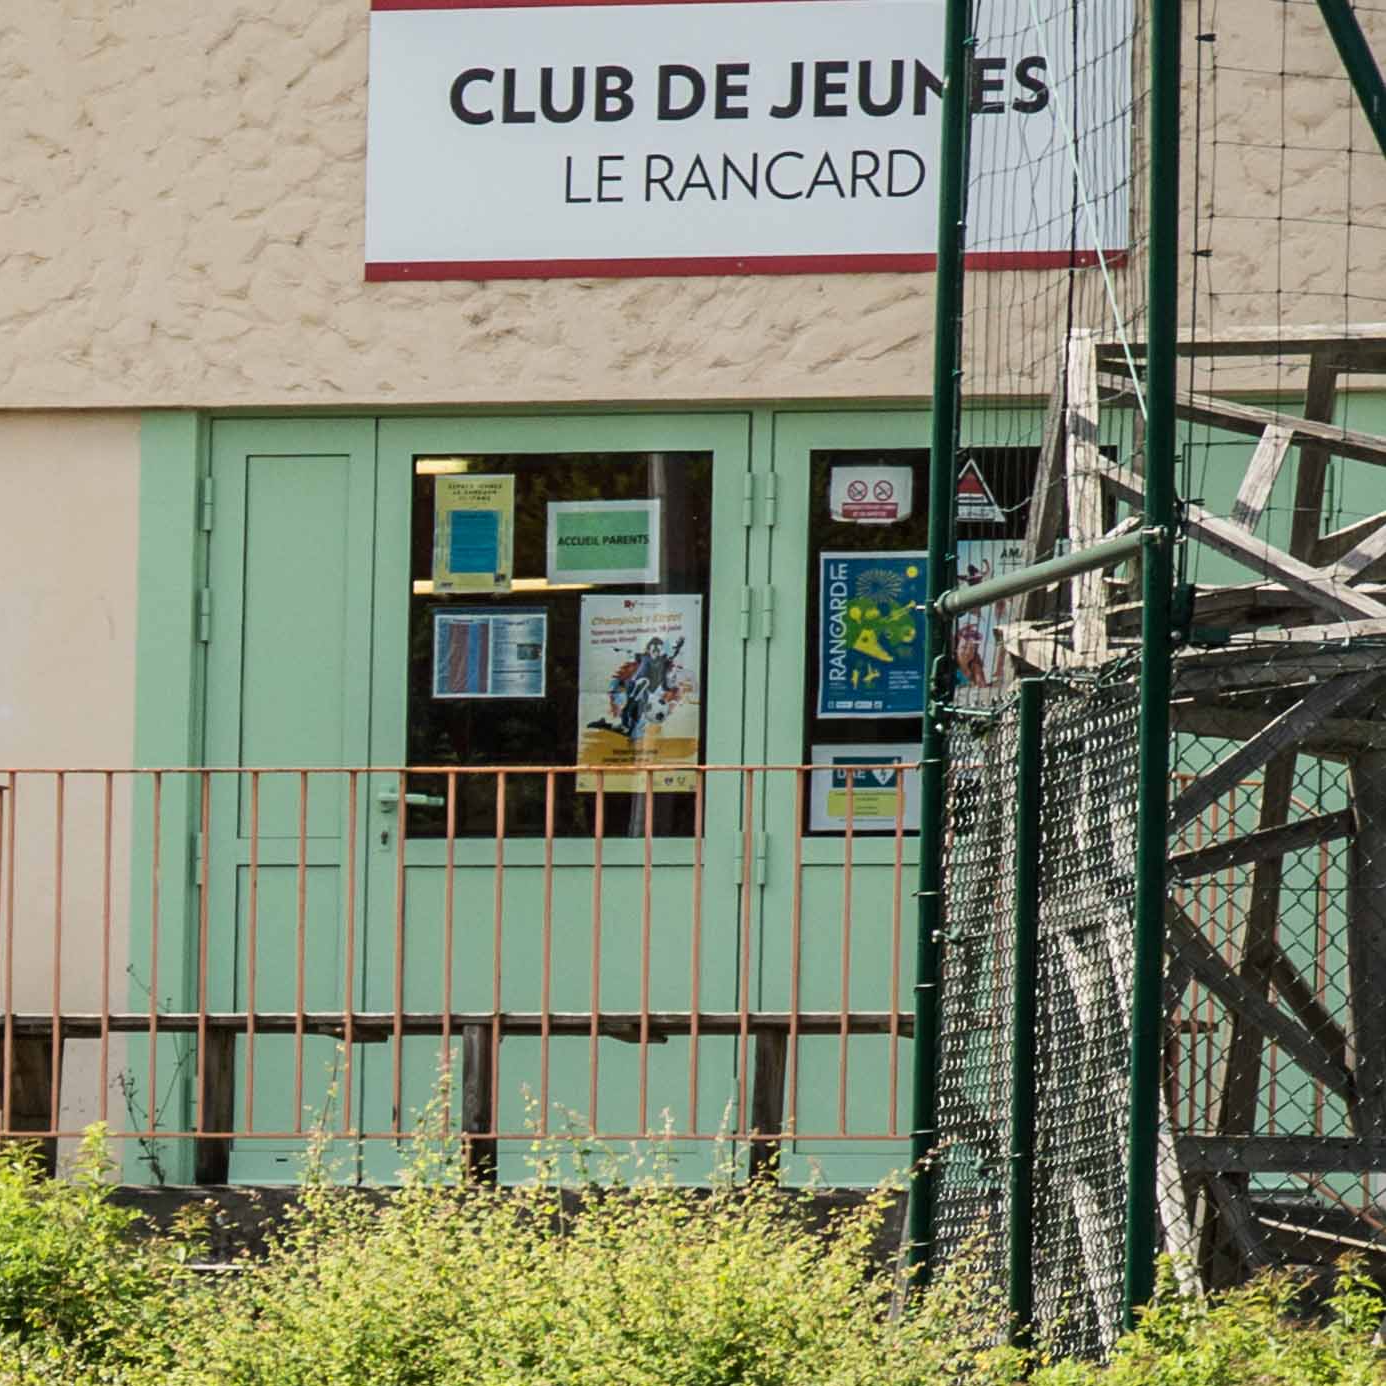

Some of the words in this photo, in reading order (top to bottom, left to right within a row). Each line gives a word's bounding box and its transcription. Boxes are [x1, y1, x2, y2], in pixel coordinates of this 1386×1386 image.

[449, 65, 635, 125] CLUB
[656, 62, 750, 121] DE
[769, 55, 1050, 119] JEUNES
[565, 154, 625, 203] LE
[644, 148, 926, 202] RANCARD
[557, 535, 600, 546] ACCUEIL
[602, 534, 650, 545] PARENTS
[836, 766, 867, 780] DE
